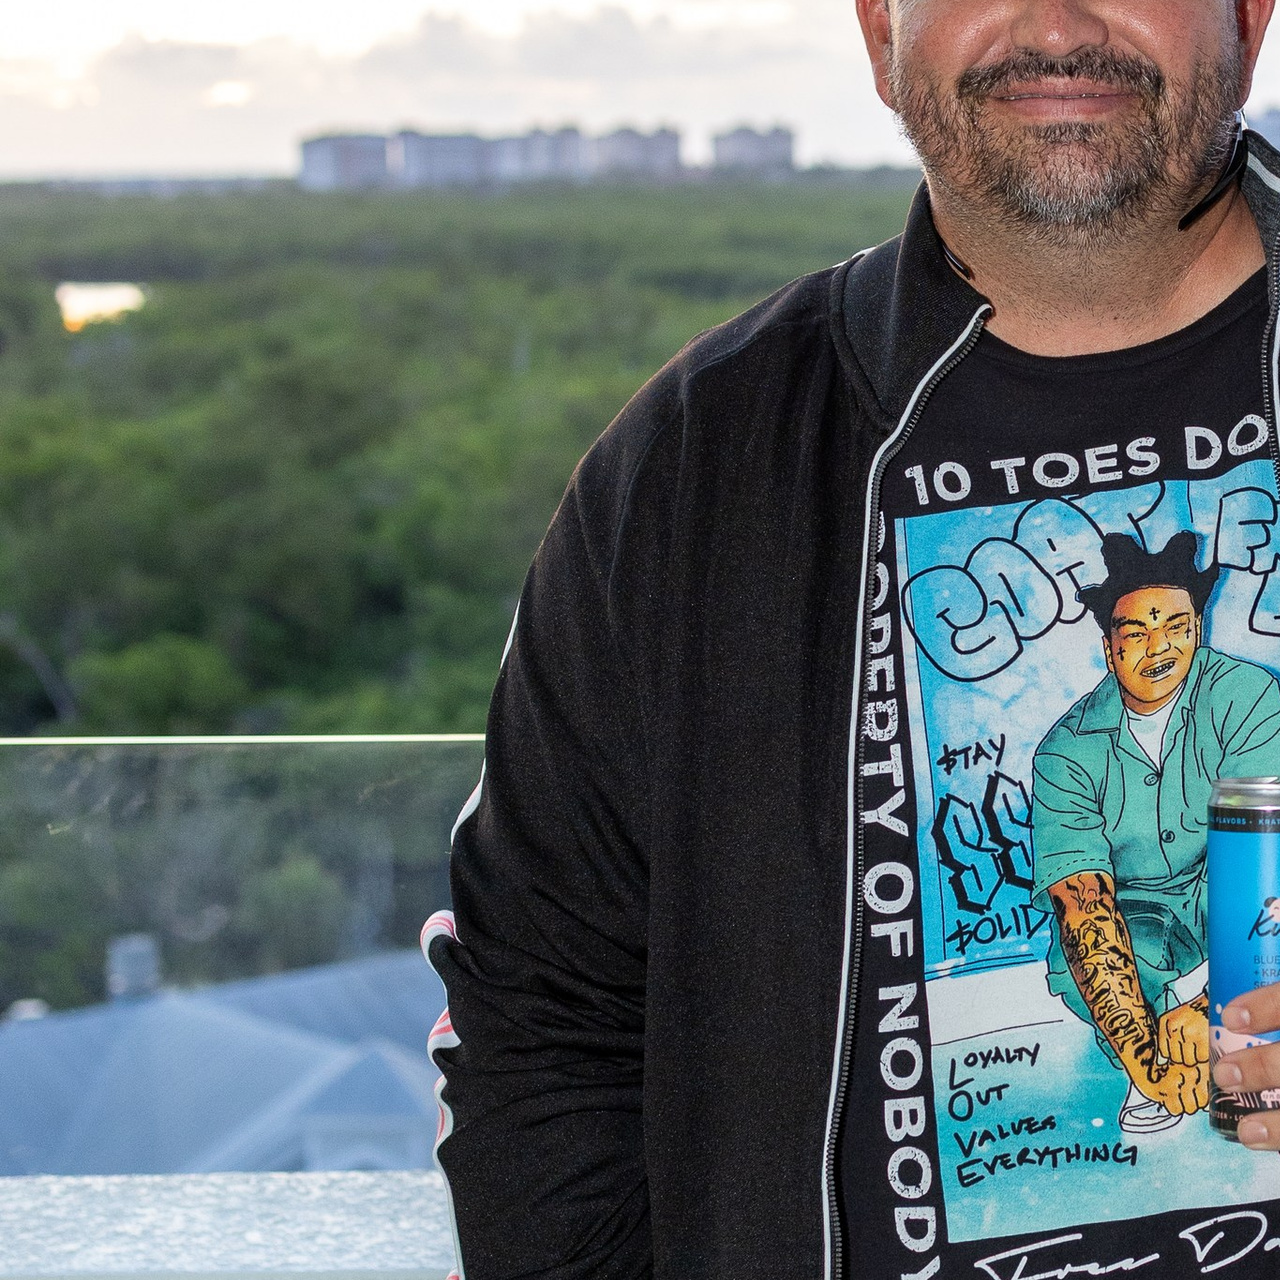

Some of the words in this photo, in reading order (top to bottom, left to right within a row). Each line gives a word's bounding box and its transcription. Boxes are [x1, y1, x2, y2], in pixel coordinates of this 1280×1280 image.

[904, 461, 972, 506] 10
[990, 436, 1161, 495] TOES
[862, 510, 909, 838] PERTY
[1215, 816, 1246, 826] FLAVORS
[862, 861, 914, 958] OF
[1253, 954, 1280, 965] BLUE
[948, 1042, 1041, 1091] LOYALTY
[947, 1083, 1010, 1122] OUT
[953, 1115, 1057, 1159] VALUES
[956, 1142, 1138, 1188] EVERYTHING
